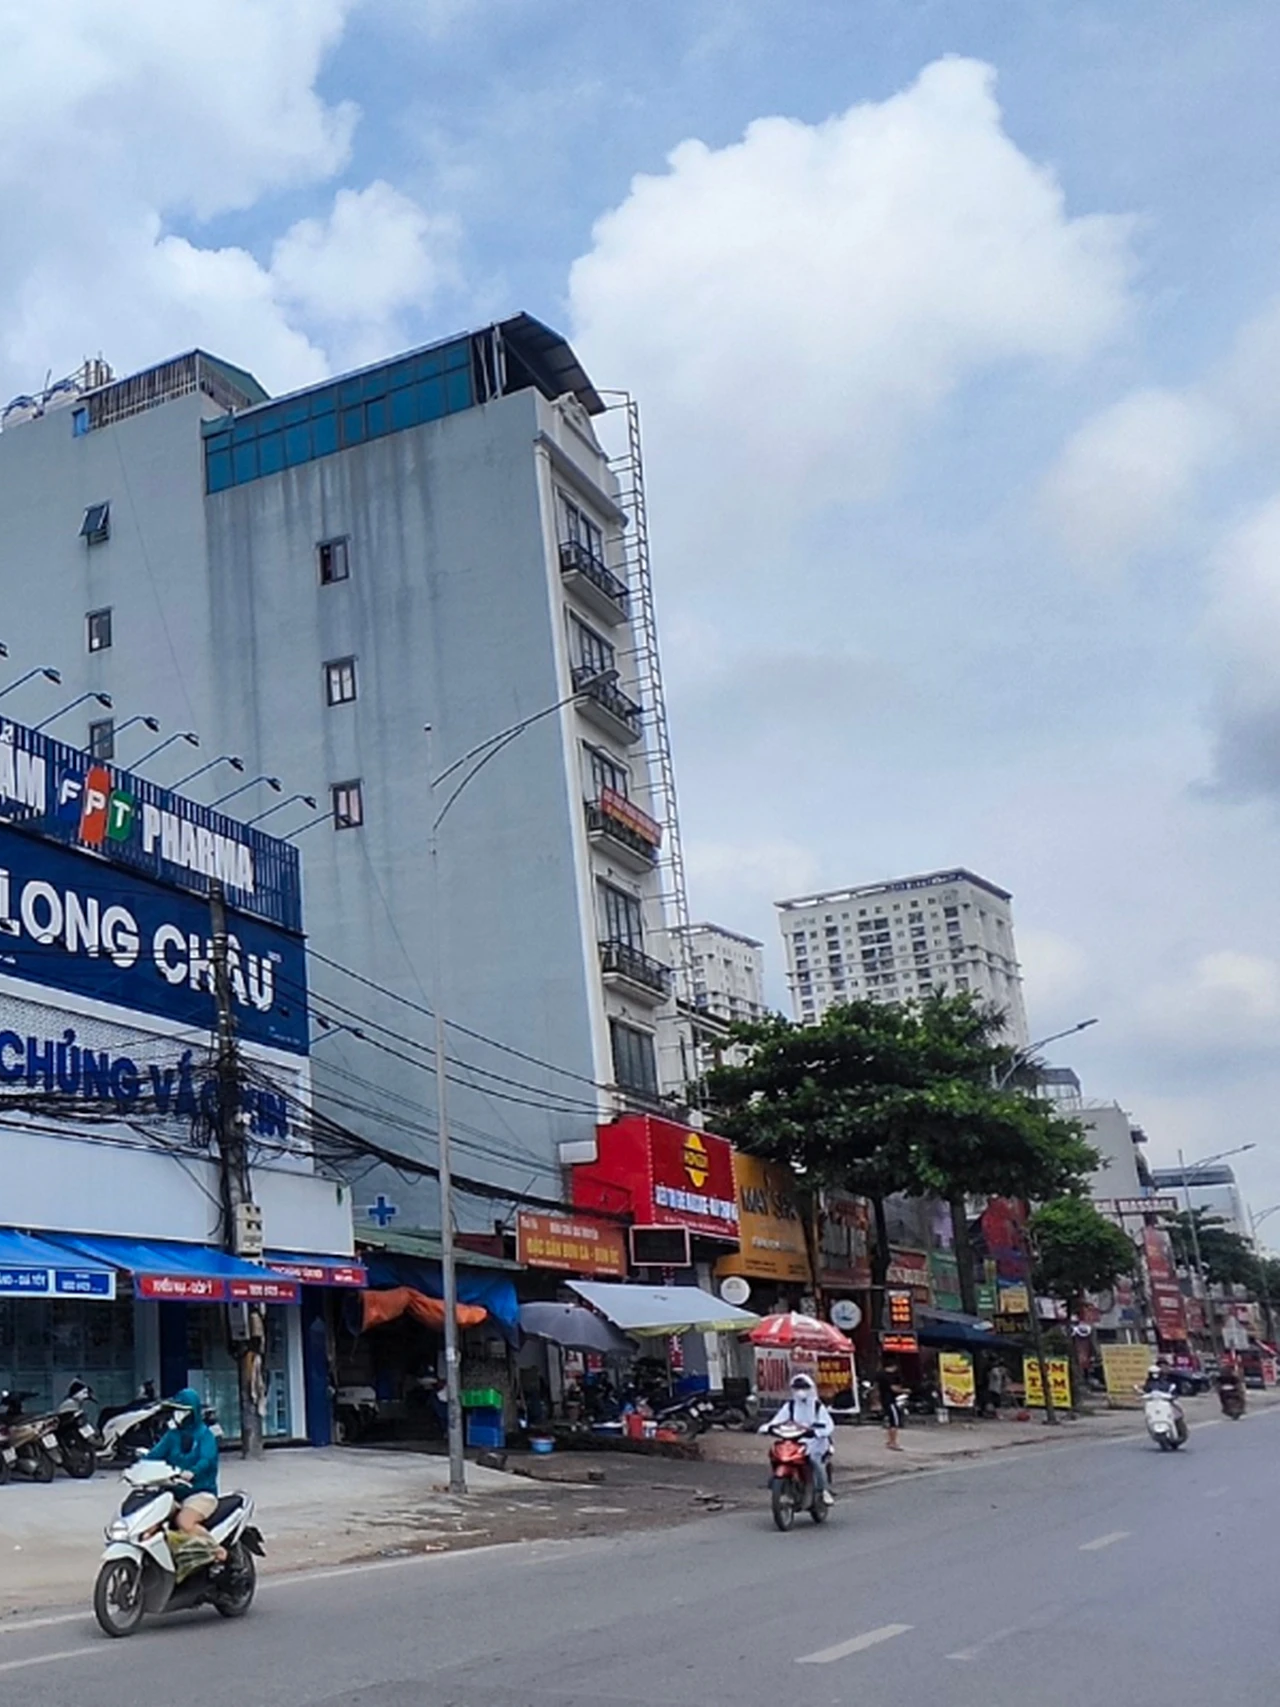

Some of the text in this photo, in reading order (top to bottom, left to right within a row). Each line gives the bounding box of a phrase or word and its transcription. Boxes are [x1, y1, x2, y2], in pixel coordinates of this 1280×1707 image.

[58, 776, 132, 830] FPT
[142, 803, 256, 894] PHARMA
[152, 923, 273, 1012] CHÂU
